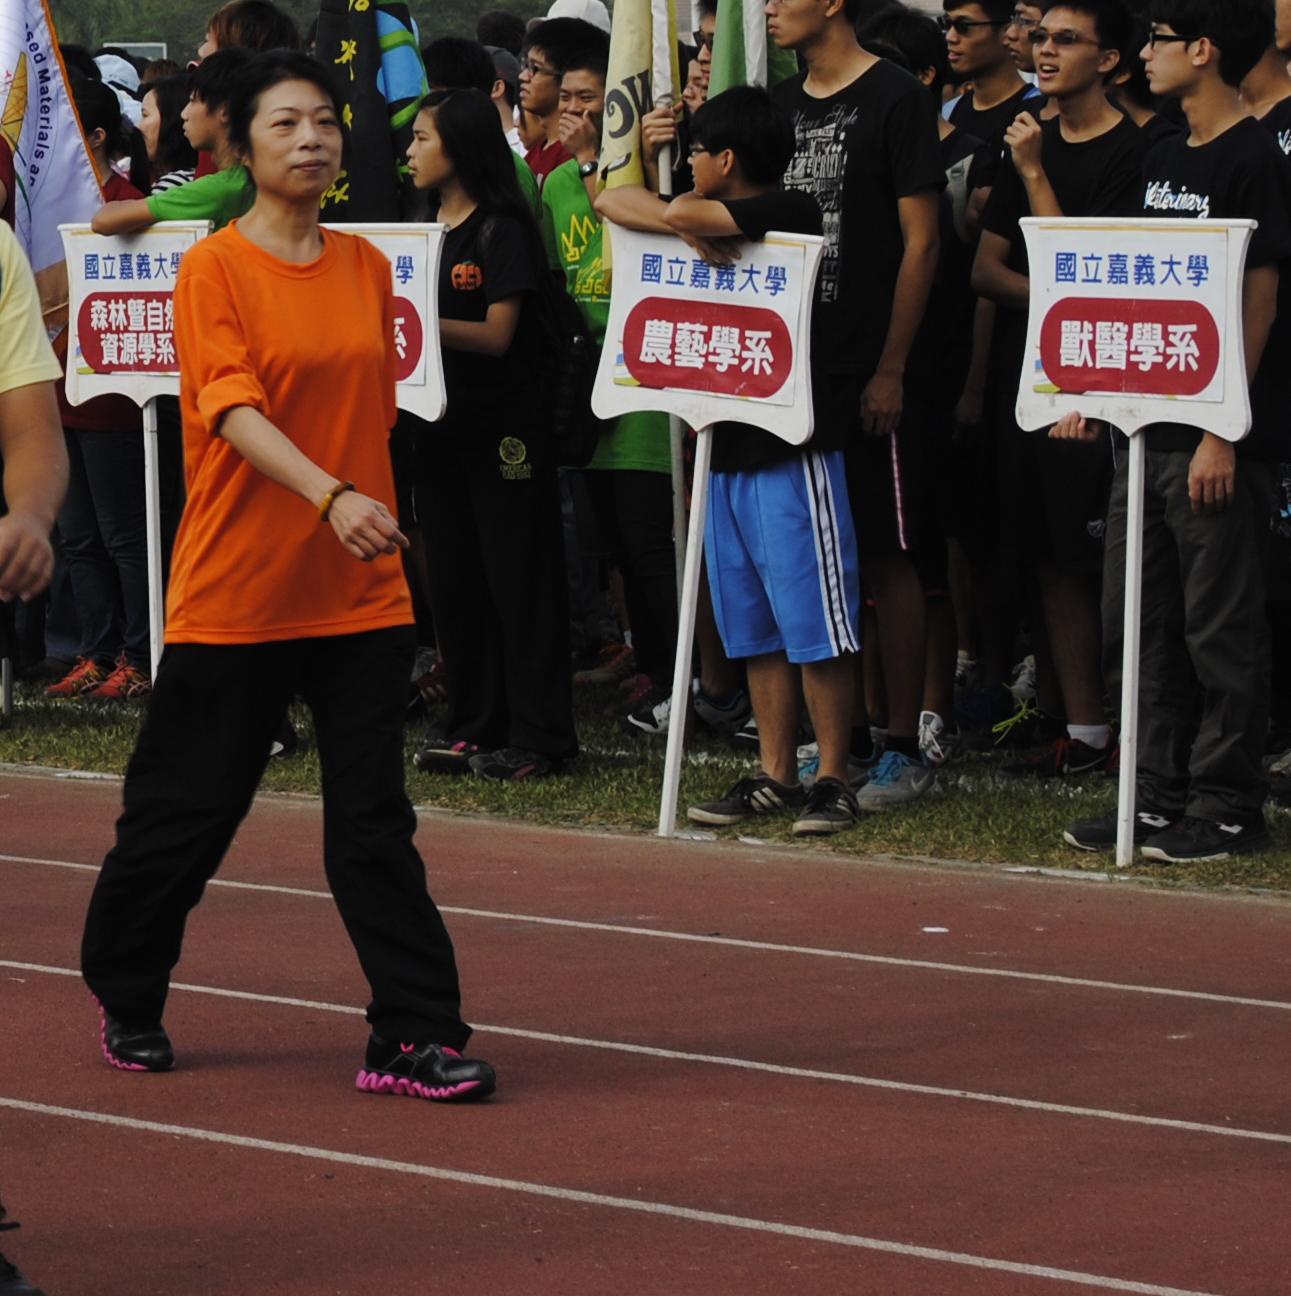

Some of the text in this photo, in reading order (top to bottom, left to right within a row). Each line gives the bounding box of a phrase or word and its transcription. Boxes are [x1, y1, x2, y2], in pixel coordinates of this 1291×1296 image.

[30, 68, 53, 159] Materials
[824, 104, 859, 134] Style
[640, 253, 787, 296] 國立嘉義大學
[1054, 252, 1209, 288] 國立嘉義大學
[100, 332, 176, 366] 資源學系
[638, 319, 775, 376] 農藝學系
[1059, 320, 1200, 373] 獸醫學系
